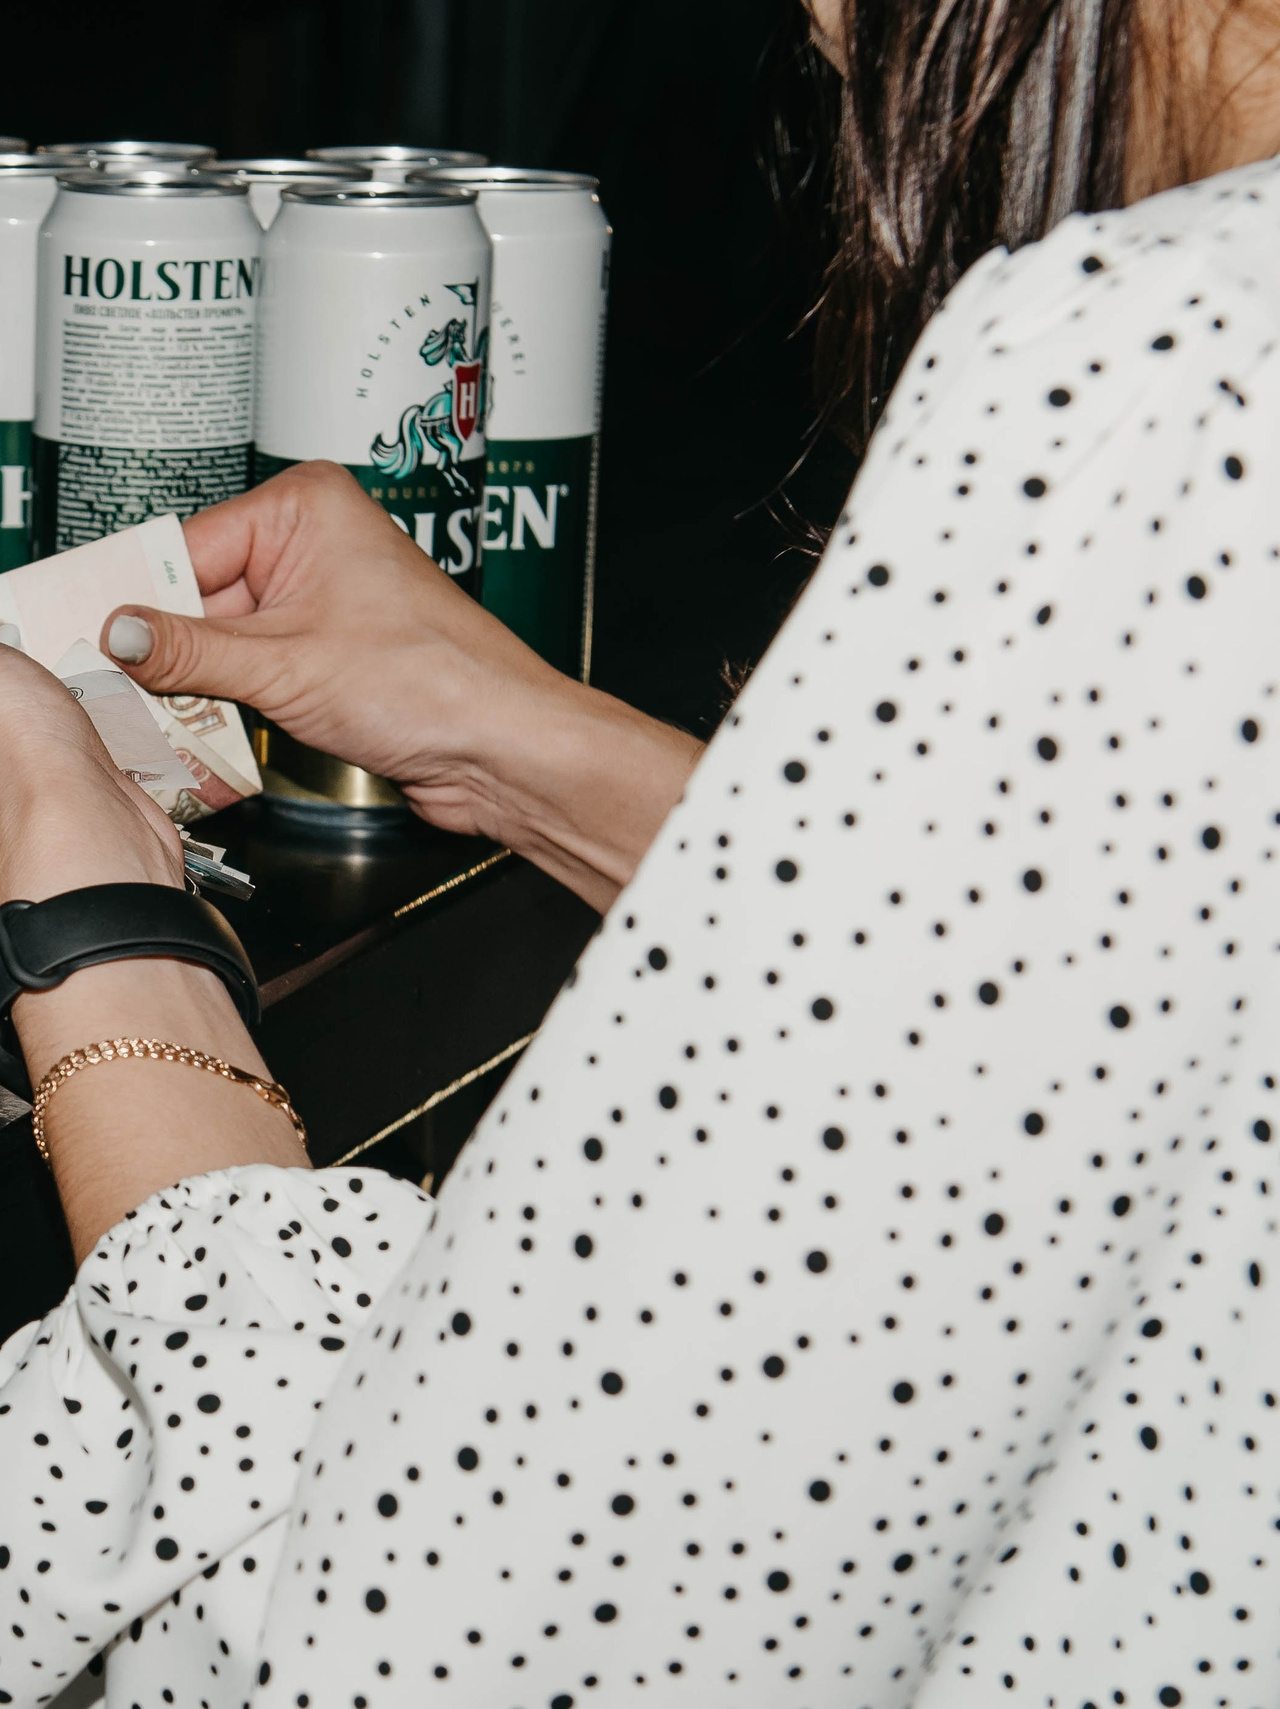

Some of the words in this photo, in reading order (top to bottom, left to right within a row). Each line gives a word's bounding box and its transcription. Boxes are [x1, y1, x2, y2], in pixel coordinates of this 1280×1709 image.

[63, 255, 255, 301] HOLSTEN
[356, 293, 431, 399] HOLSTEN
[460, 382, 476, 420] H
